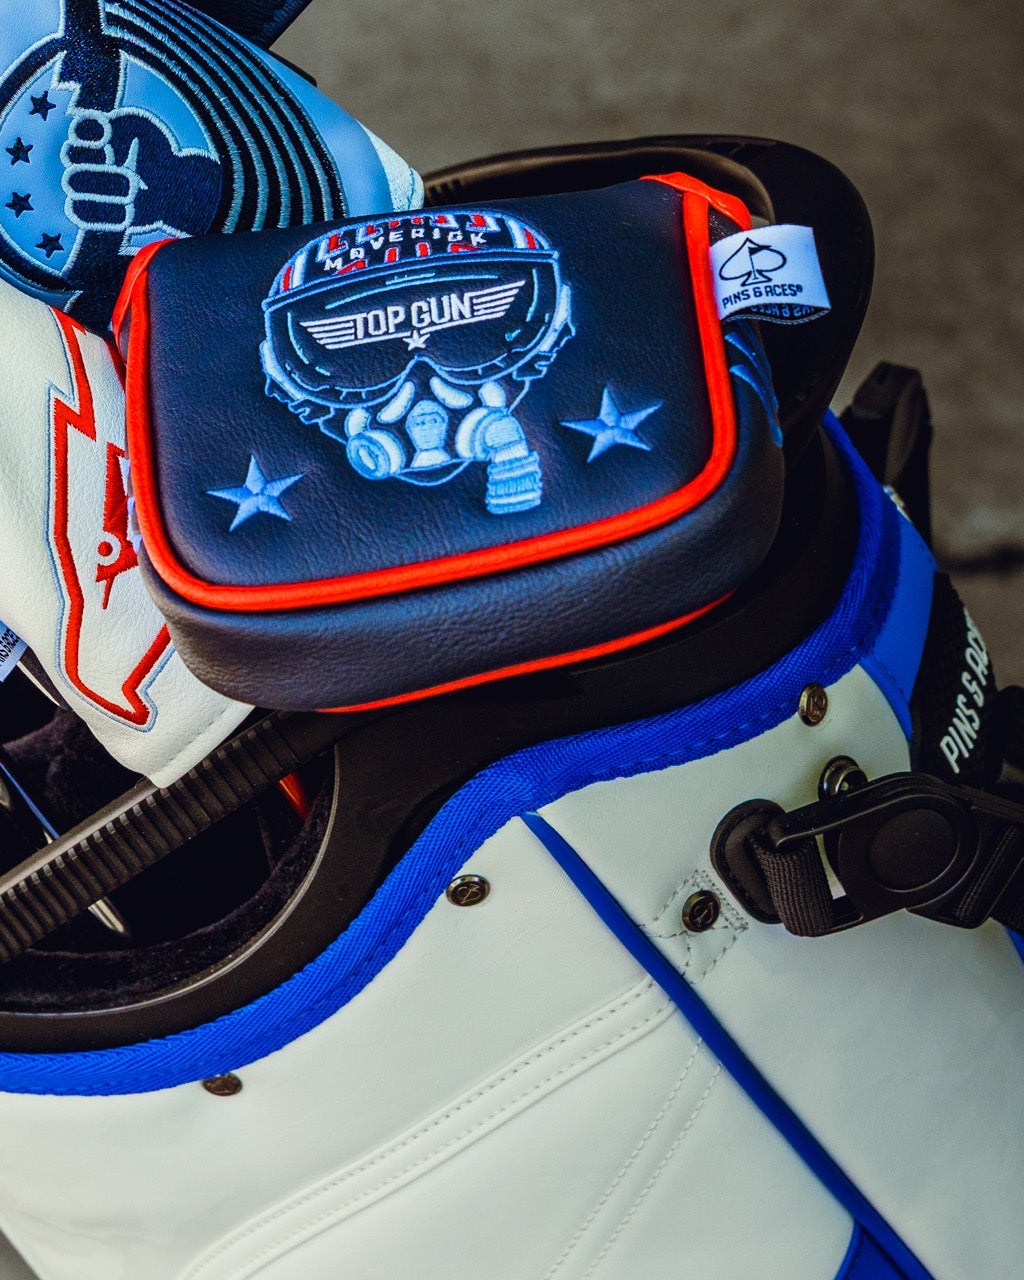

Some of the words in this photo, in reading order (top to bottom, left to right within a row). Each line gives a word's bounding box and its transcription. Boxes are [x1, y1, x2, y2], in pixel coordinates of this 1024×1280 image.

[324, 227, 488, 271] MAVERICK
[353, 305, 406, 340] TOP
[410, 292, 473, 328] GUN
[722, 289, 750, 309] PINS
[940, 694, 980, 774] PINS
